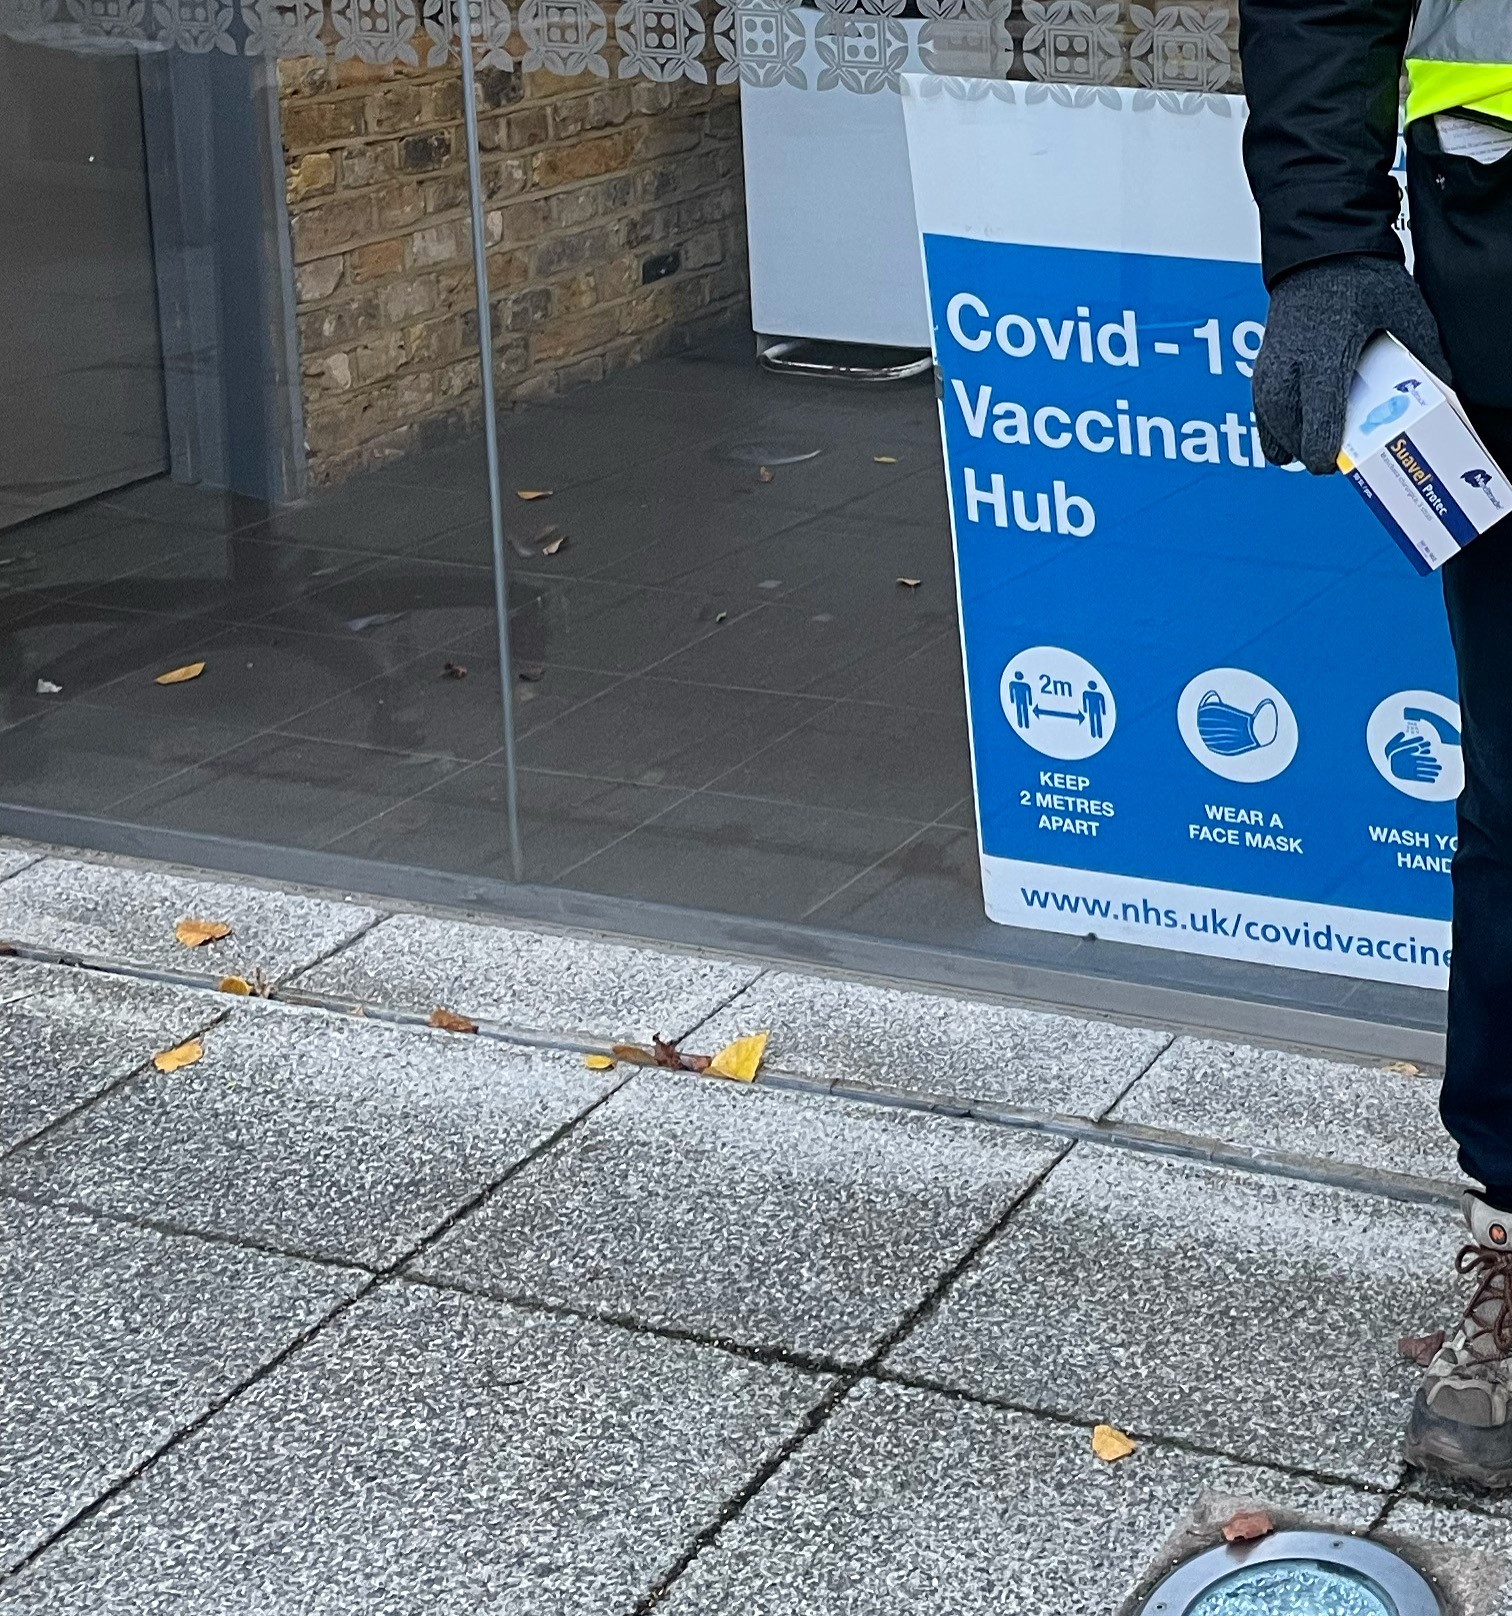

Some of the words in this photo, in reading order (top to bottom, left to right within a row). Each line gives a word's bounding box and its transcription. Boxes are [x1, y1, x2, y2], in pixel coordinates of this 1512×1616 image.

[951, 379, 1307, 472] Vaccinati
[1391, 438, 1432, 485] Suavel
[1422, 483, 1448, 516] Protec
[964, 467, 1096, 537] Hub
[1039, 674, 1073, 697] 2m
[1040, 771, 1090, 792] KEEP
[1020, 790, 1031, 806] 2
[1035, 792, 1115, 818] METRES
[1204, 804, 1264, 827] WEAR
[1268, 813, 1284, 830] A
[1038, 815, 1099, 837] APART
[1188, 824, 1240, 847] FACE
[1245, 832, 1304, 855] MASK
[1368, 825, 1429, 849] WASH
